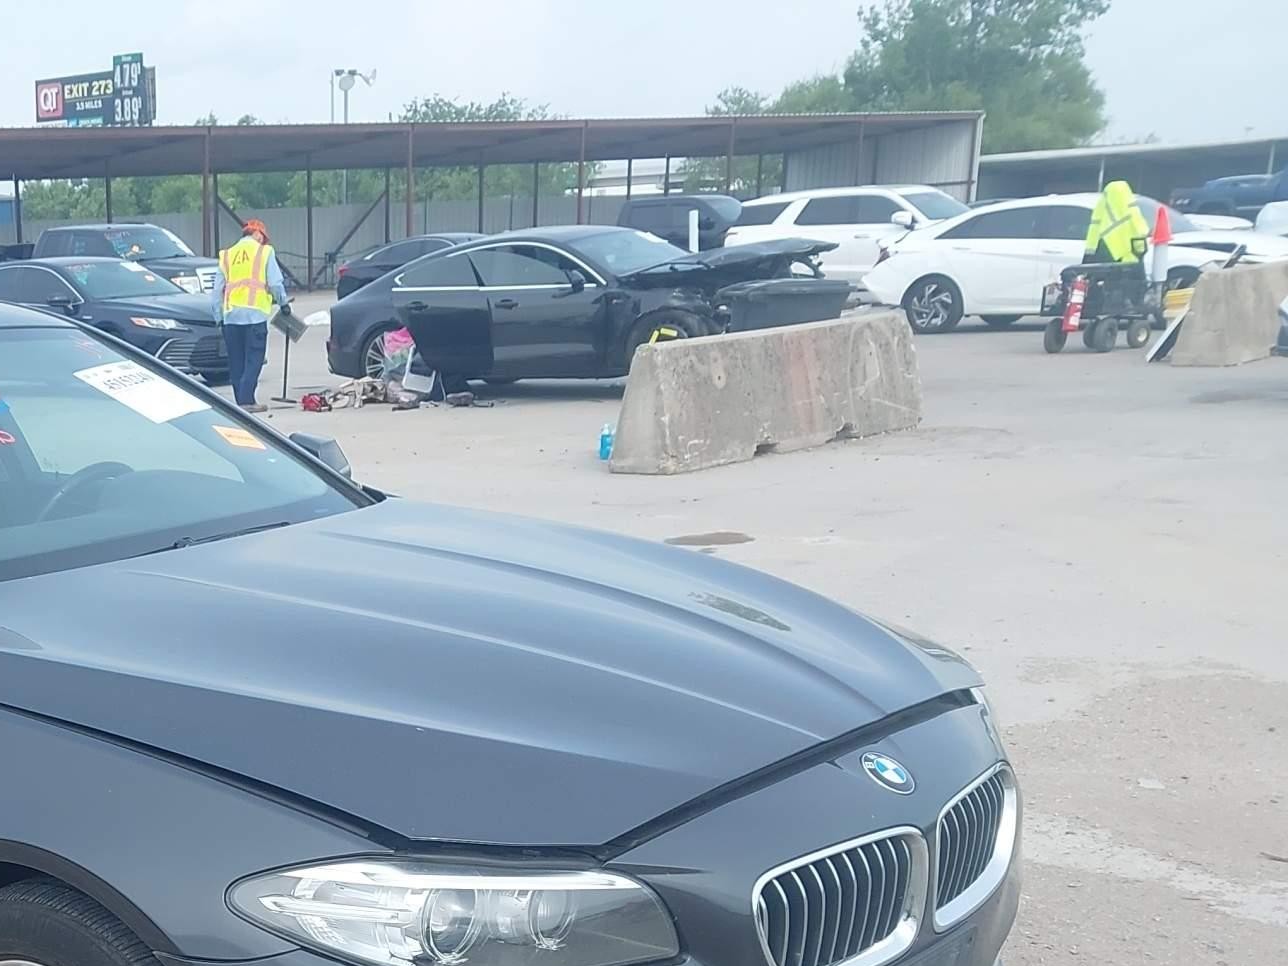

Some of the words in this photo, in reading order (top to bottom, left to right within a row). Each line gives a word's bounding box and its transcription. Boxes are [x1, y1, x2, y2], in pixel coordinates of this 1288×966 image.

[40, 88, 59, 112] QT
[64, 82, 89, 99] EXIT
[92, 79, 113, 96] 273
